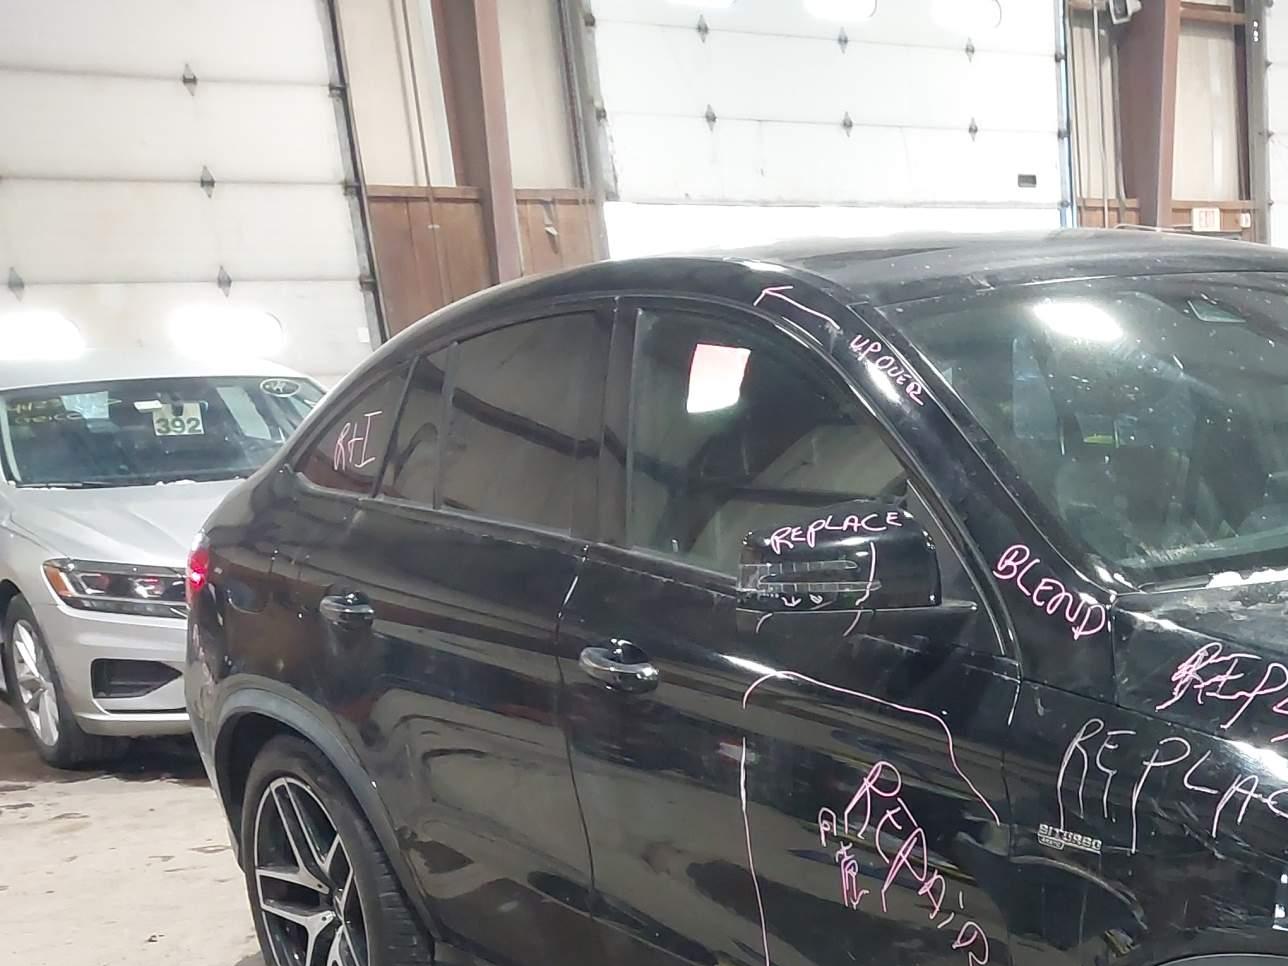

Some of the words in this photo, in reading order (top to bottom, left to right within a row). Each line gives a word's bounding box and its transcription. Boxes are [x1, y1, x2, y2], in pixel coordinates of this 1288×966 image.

[849, 334, 882, 361] UP
[155, 417, 202, 434] 392
[770, 511, 903, 556] REPLACE
[992, 544, 1106, 641] BLEND
[1039, 823, 1103, 851] BITURBO
